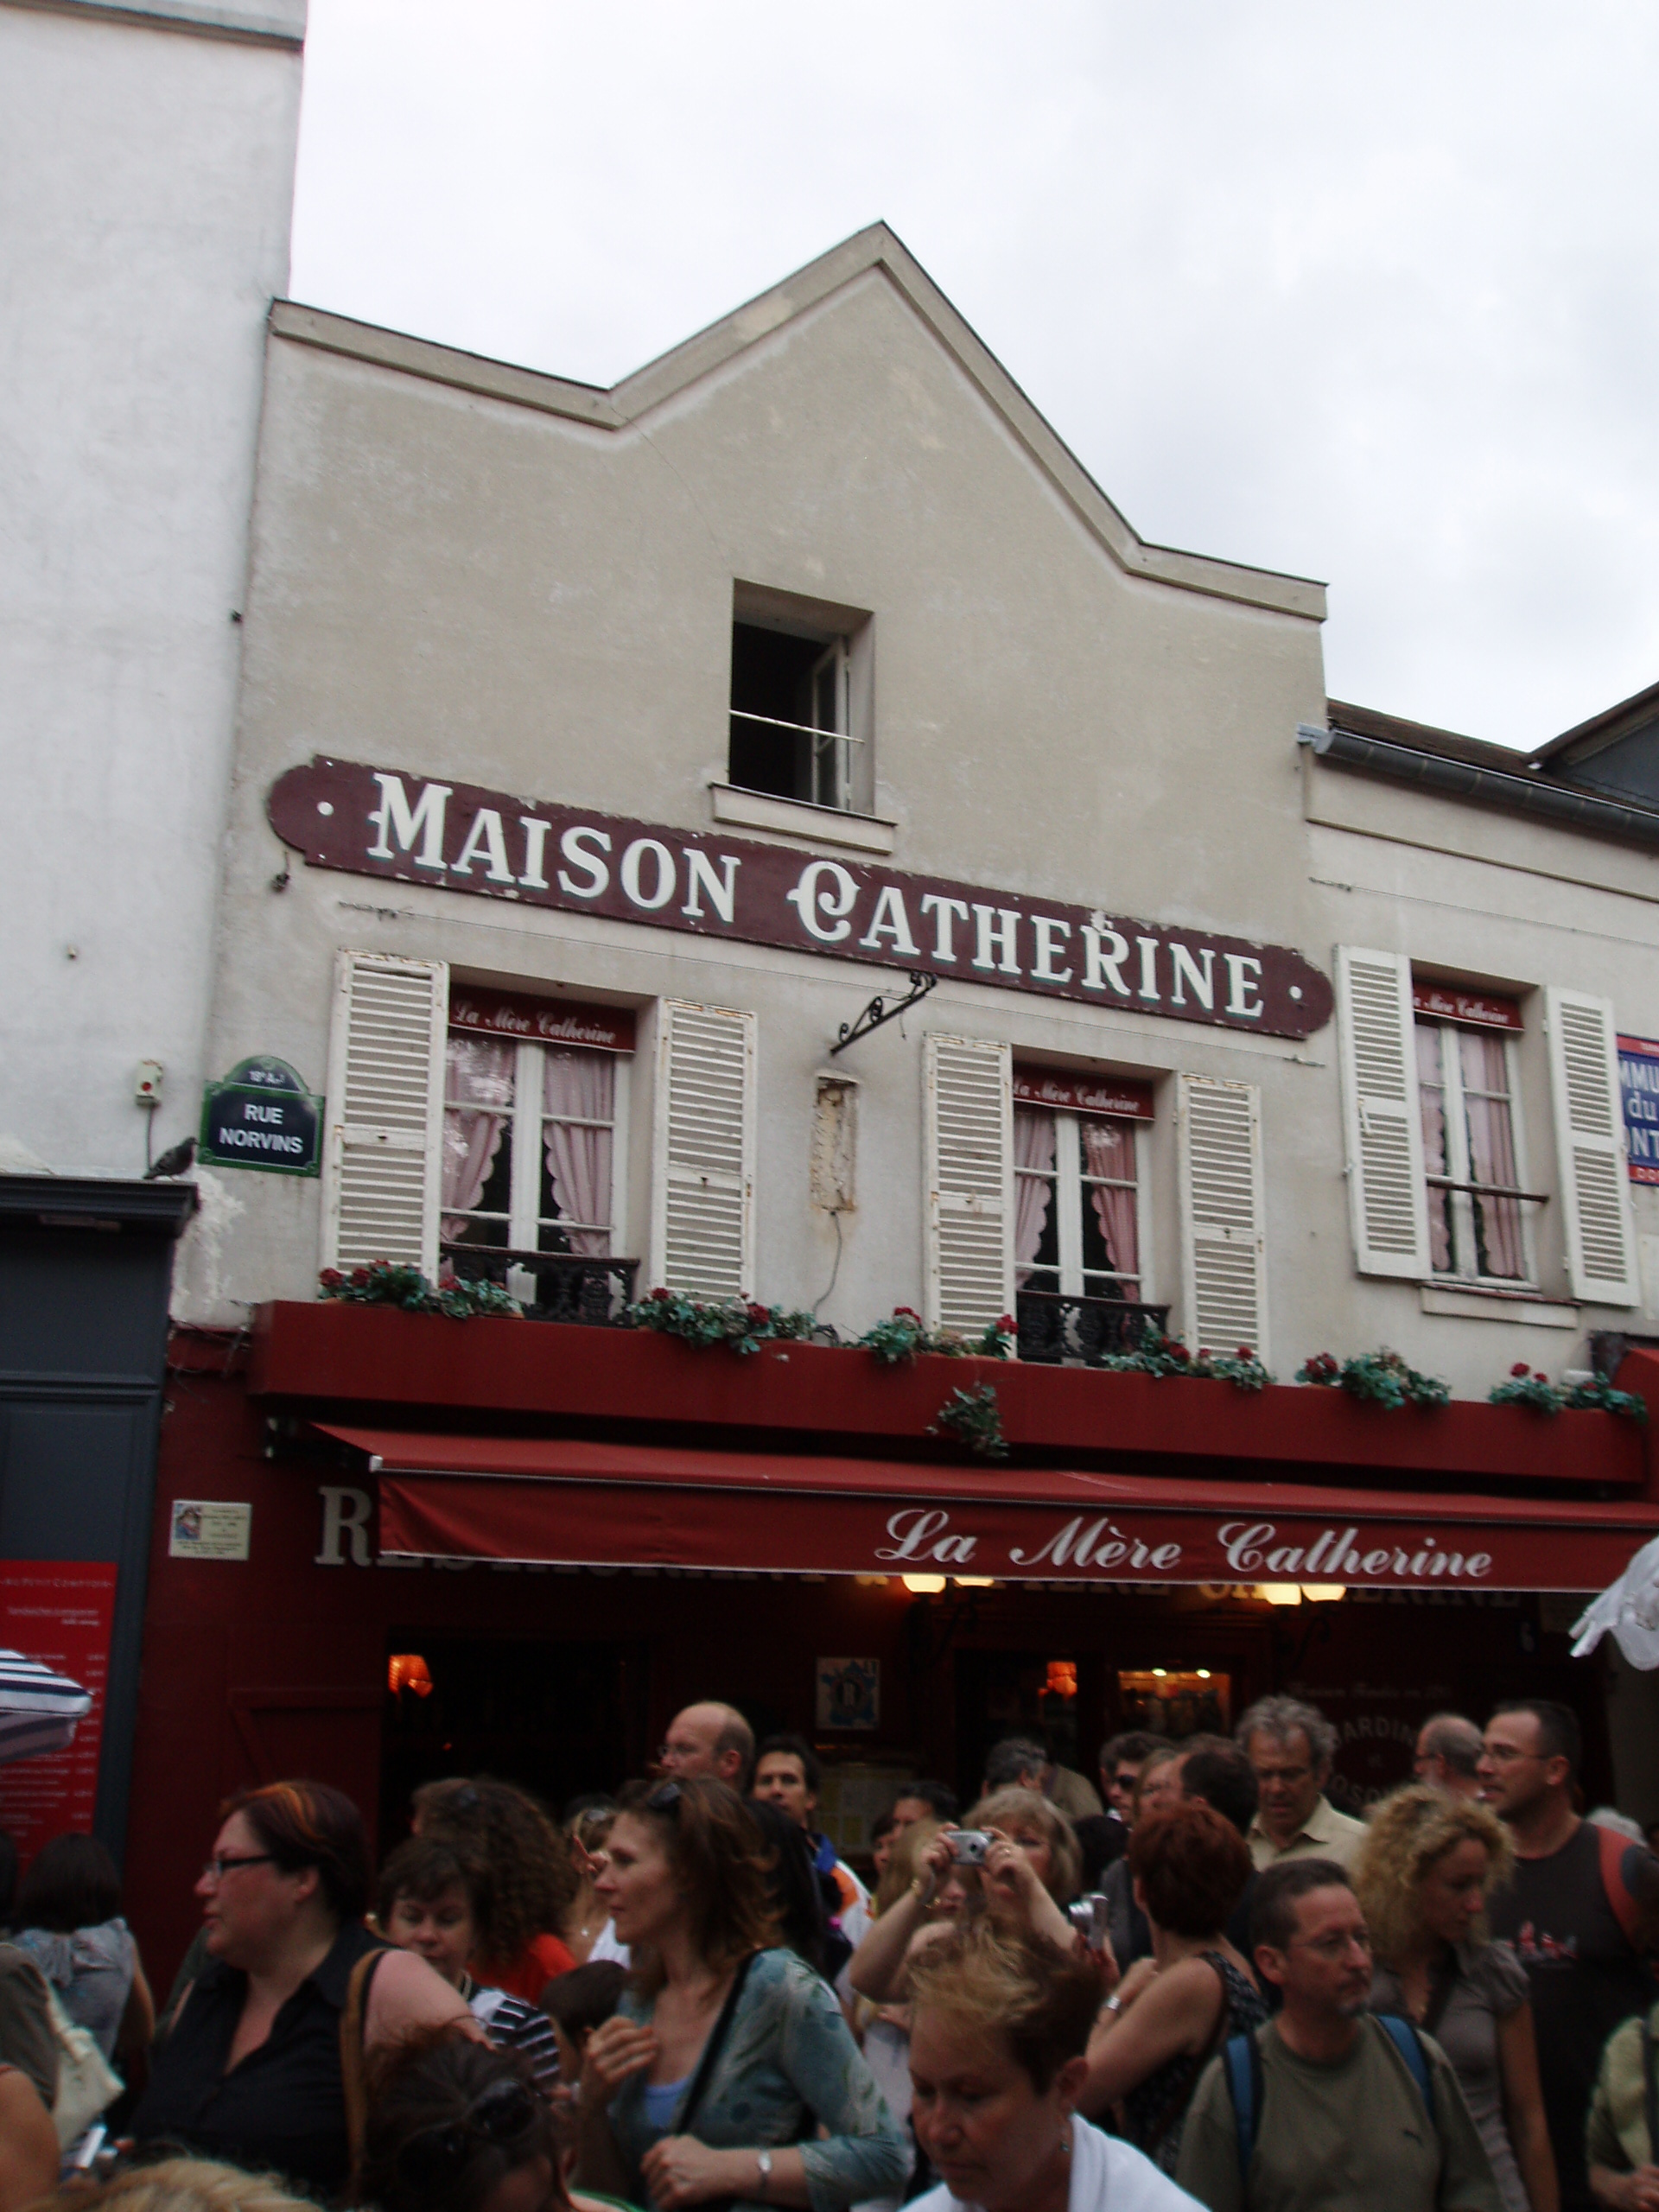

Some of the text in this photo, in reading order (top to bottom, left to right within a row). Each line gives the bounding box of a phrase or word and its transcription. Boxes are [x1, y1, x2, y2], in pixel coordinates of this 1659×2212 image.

[366, 772, 1264, 1018] MAISON CATHERINE
[454, 1000, 480, 1024] La
[536, 1010, 616, 1044] Catherine
[244, 1103, 283, 1124] RUE
[1628, 1090, 1657, 1121] du
[219, 1128, 303, 1154] NORVINS
[874, 1509, 977, 1563] La
[1009, 1516, 1181, 1569] Mère
[1217, 1522, 1492, 1578] Catherine
